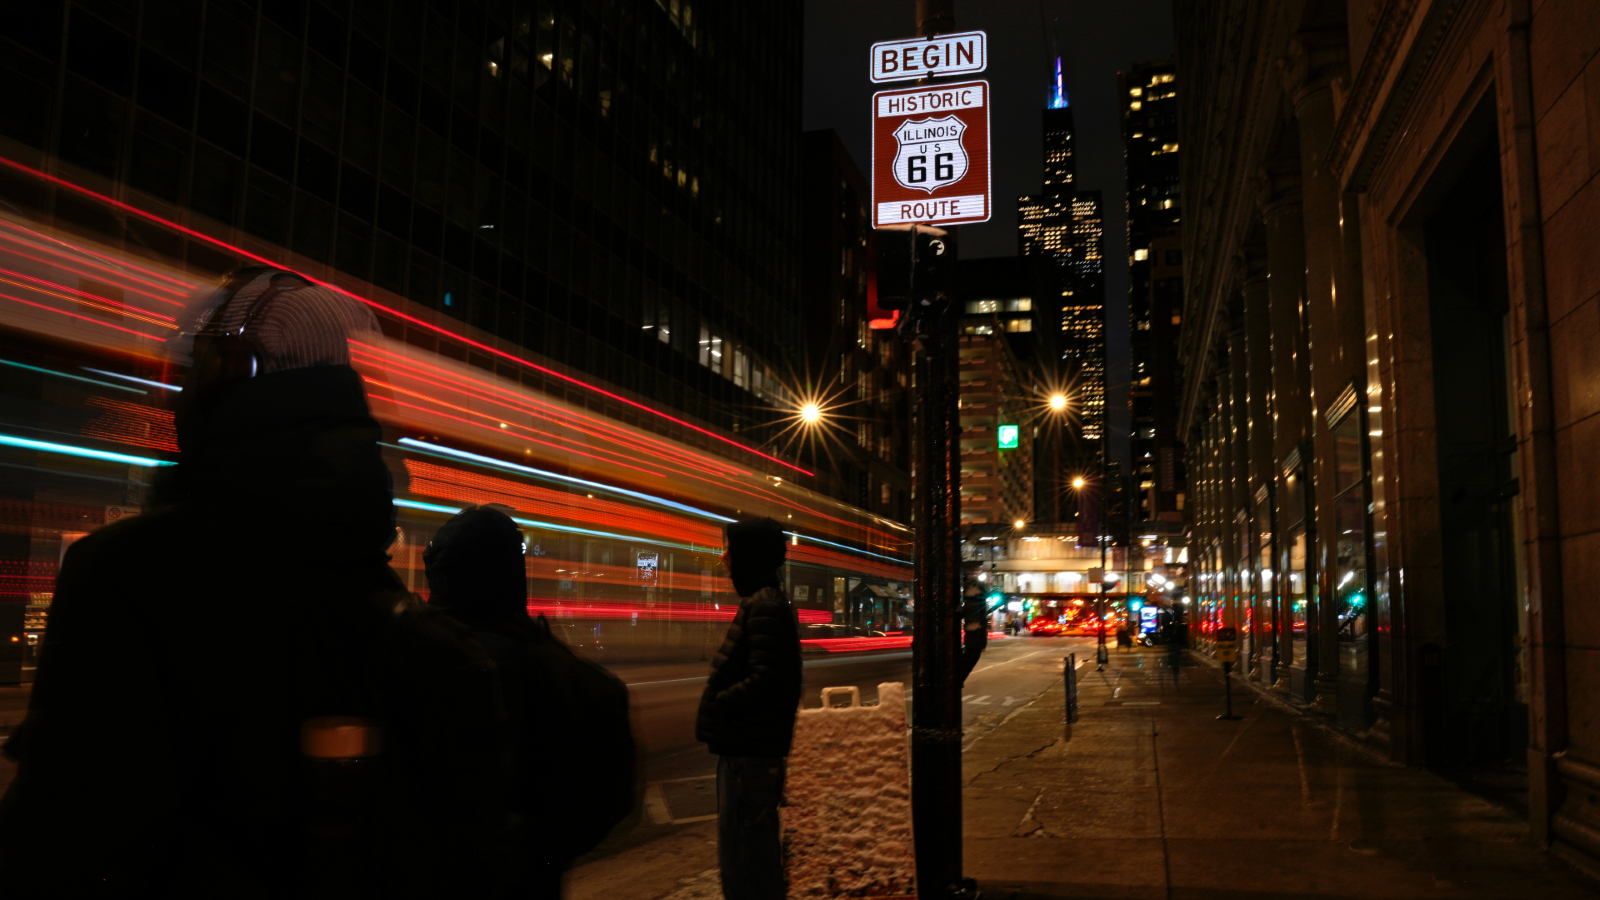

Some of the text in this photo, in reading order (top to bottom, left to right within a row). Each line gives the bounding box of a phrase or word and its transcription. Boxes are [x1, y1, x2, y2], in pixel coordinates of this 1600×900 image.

[881, 41, 974, 73] BEGIN
[888, 90, 972, 113] HISTORIC
[903, 125, 958, 141] ILLINOIS
[907, 152, 954, 183] 66
[901, 200, 961, 219] ROUTE
